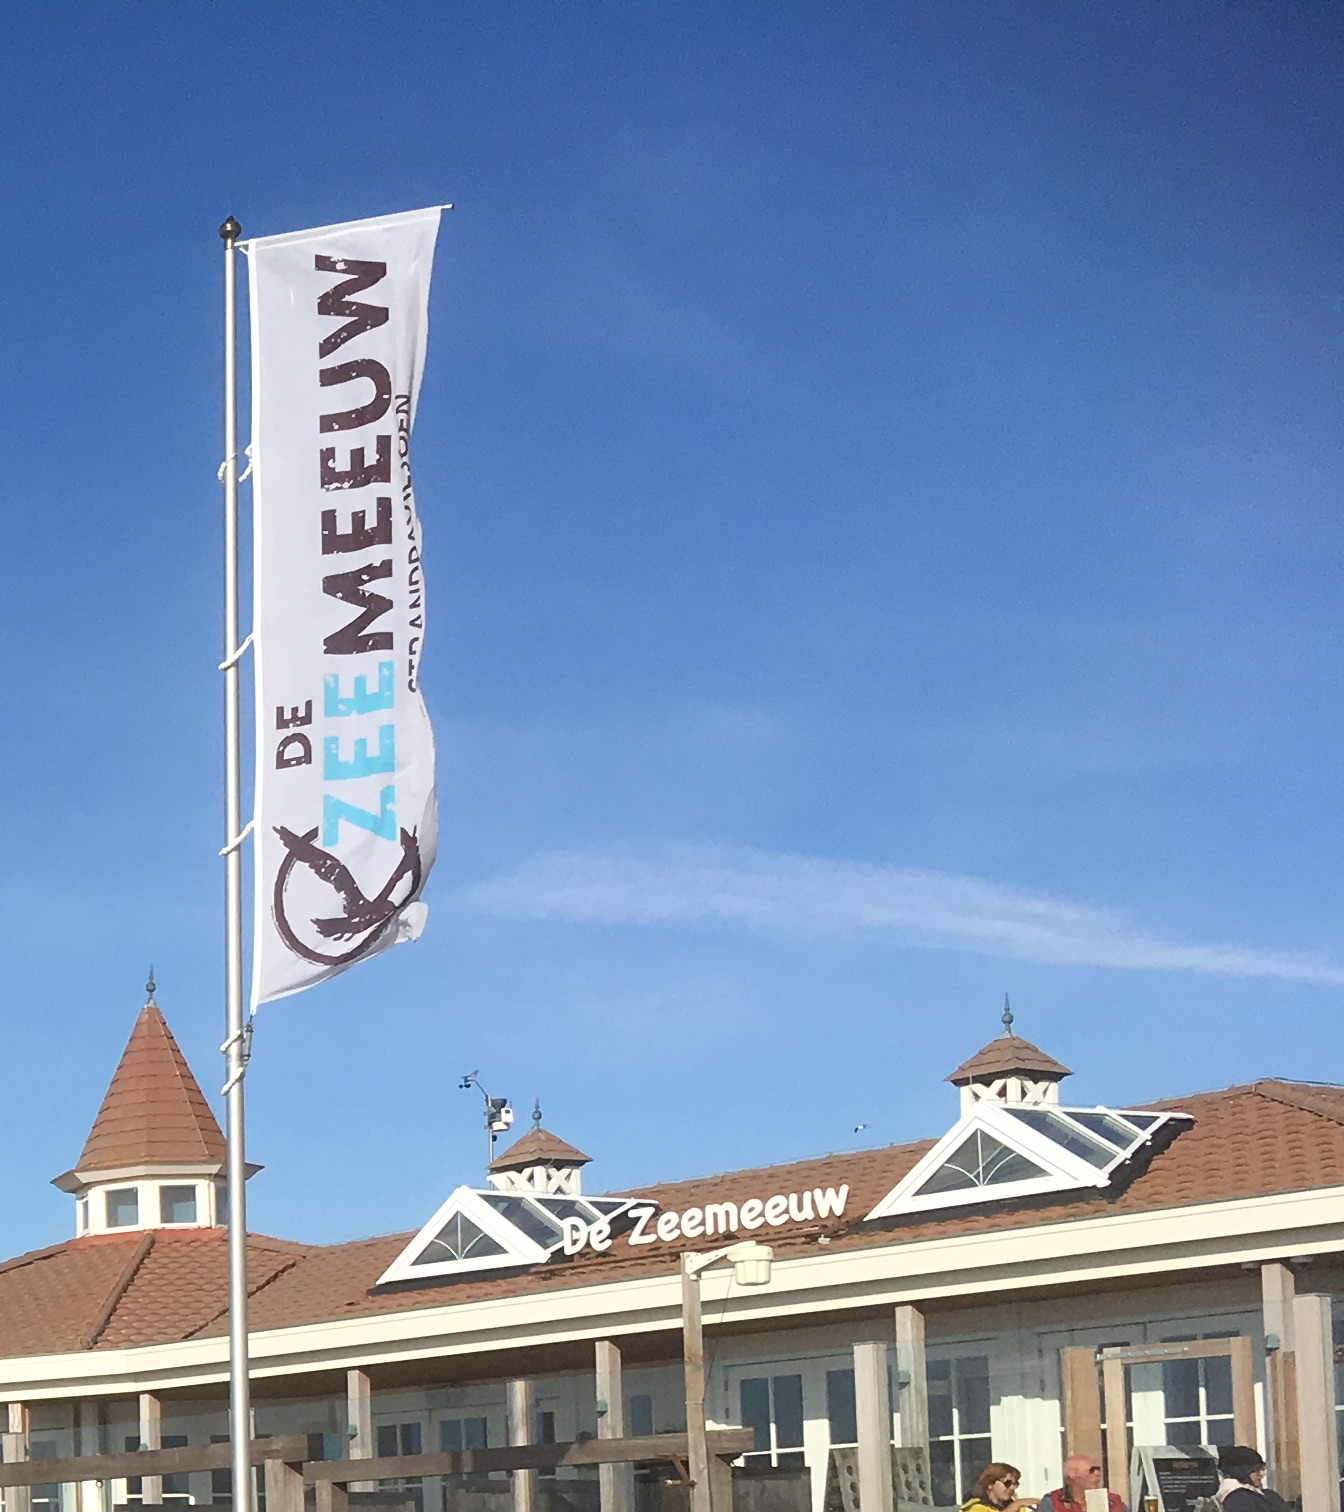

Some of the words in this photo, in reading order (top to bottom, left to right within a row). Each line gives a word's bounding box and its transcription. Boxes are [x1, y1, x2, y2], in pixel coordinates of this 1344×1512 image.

[315, 253, 396, 847] ZEEMEEUW
[275, 699, 313, 770] DE
[562, 1216, 612, 1256] De
[628, 1184, 850, 1246] Zeemeeuw
